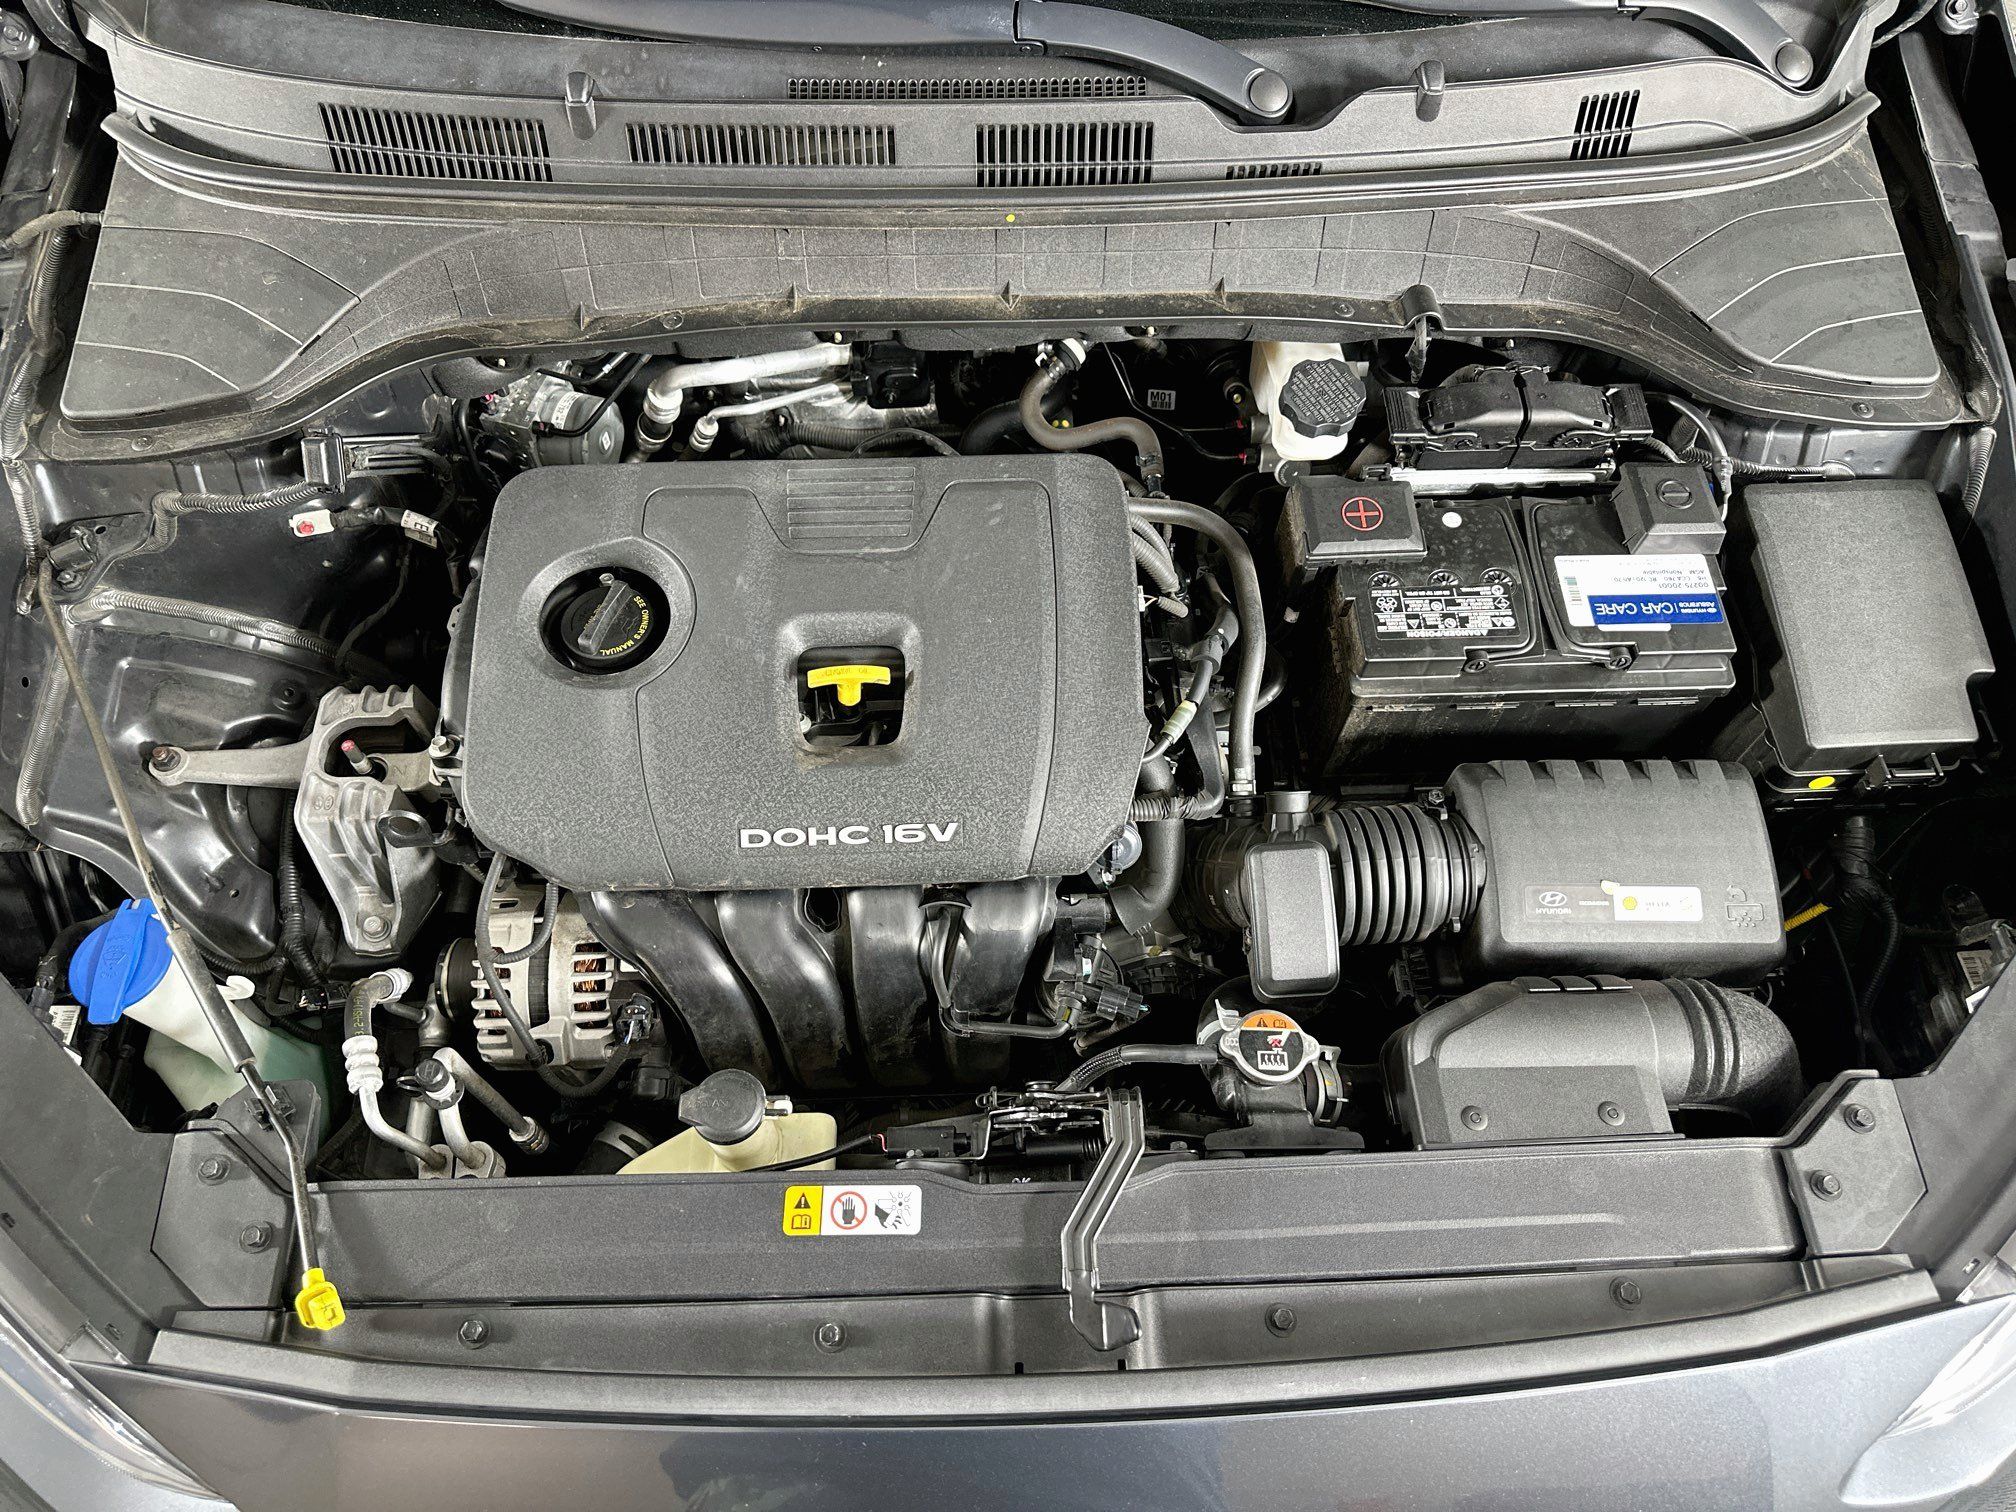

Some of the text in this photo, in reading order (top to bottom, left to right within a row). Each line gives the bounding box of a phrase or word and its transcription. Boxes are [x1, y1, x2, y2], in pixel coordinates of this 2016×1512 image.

[1150, 391, 1171, 401] M01
[1594, 602, 1674, 615] CAR CARE
[600, 596, 649, 656] SEE OWNER'S MANUAL
[740, 822, 958, 848] DOHC 16V
